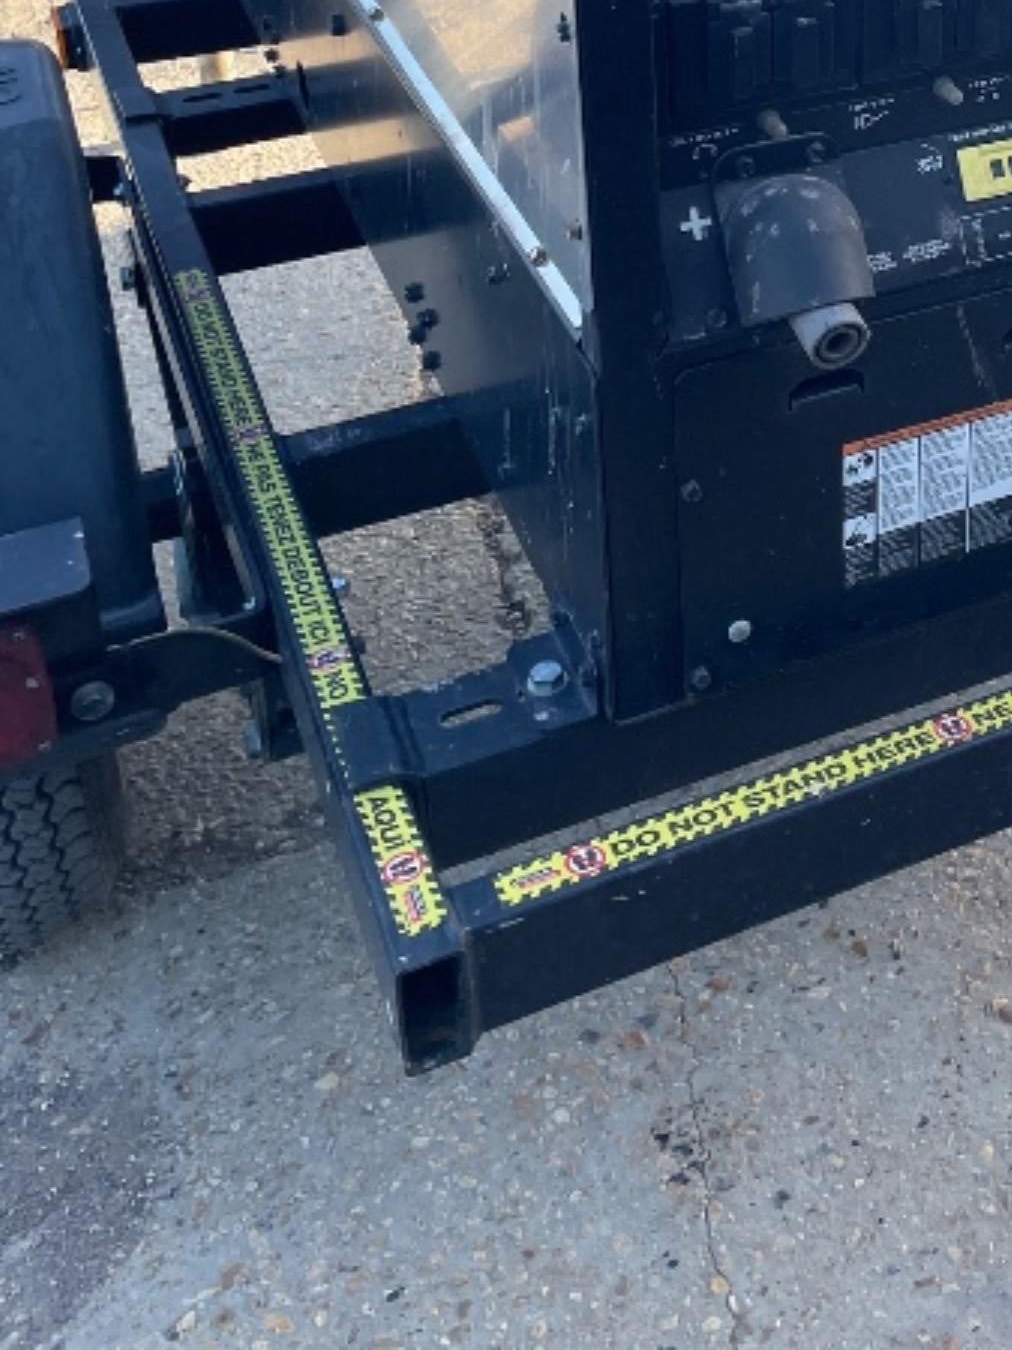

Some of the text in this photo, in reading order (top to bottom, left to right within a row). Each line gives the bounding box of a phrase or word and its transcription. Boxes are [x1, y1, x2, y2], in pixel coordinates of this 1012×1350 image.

[611, 731, 938, 855] DO NOT STAND HERE
